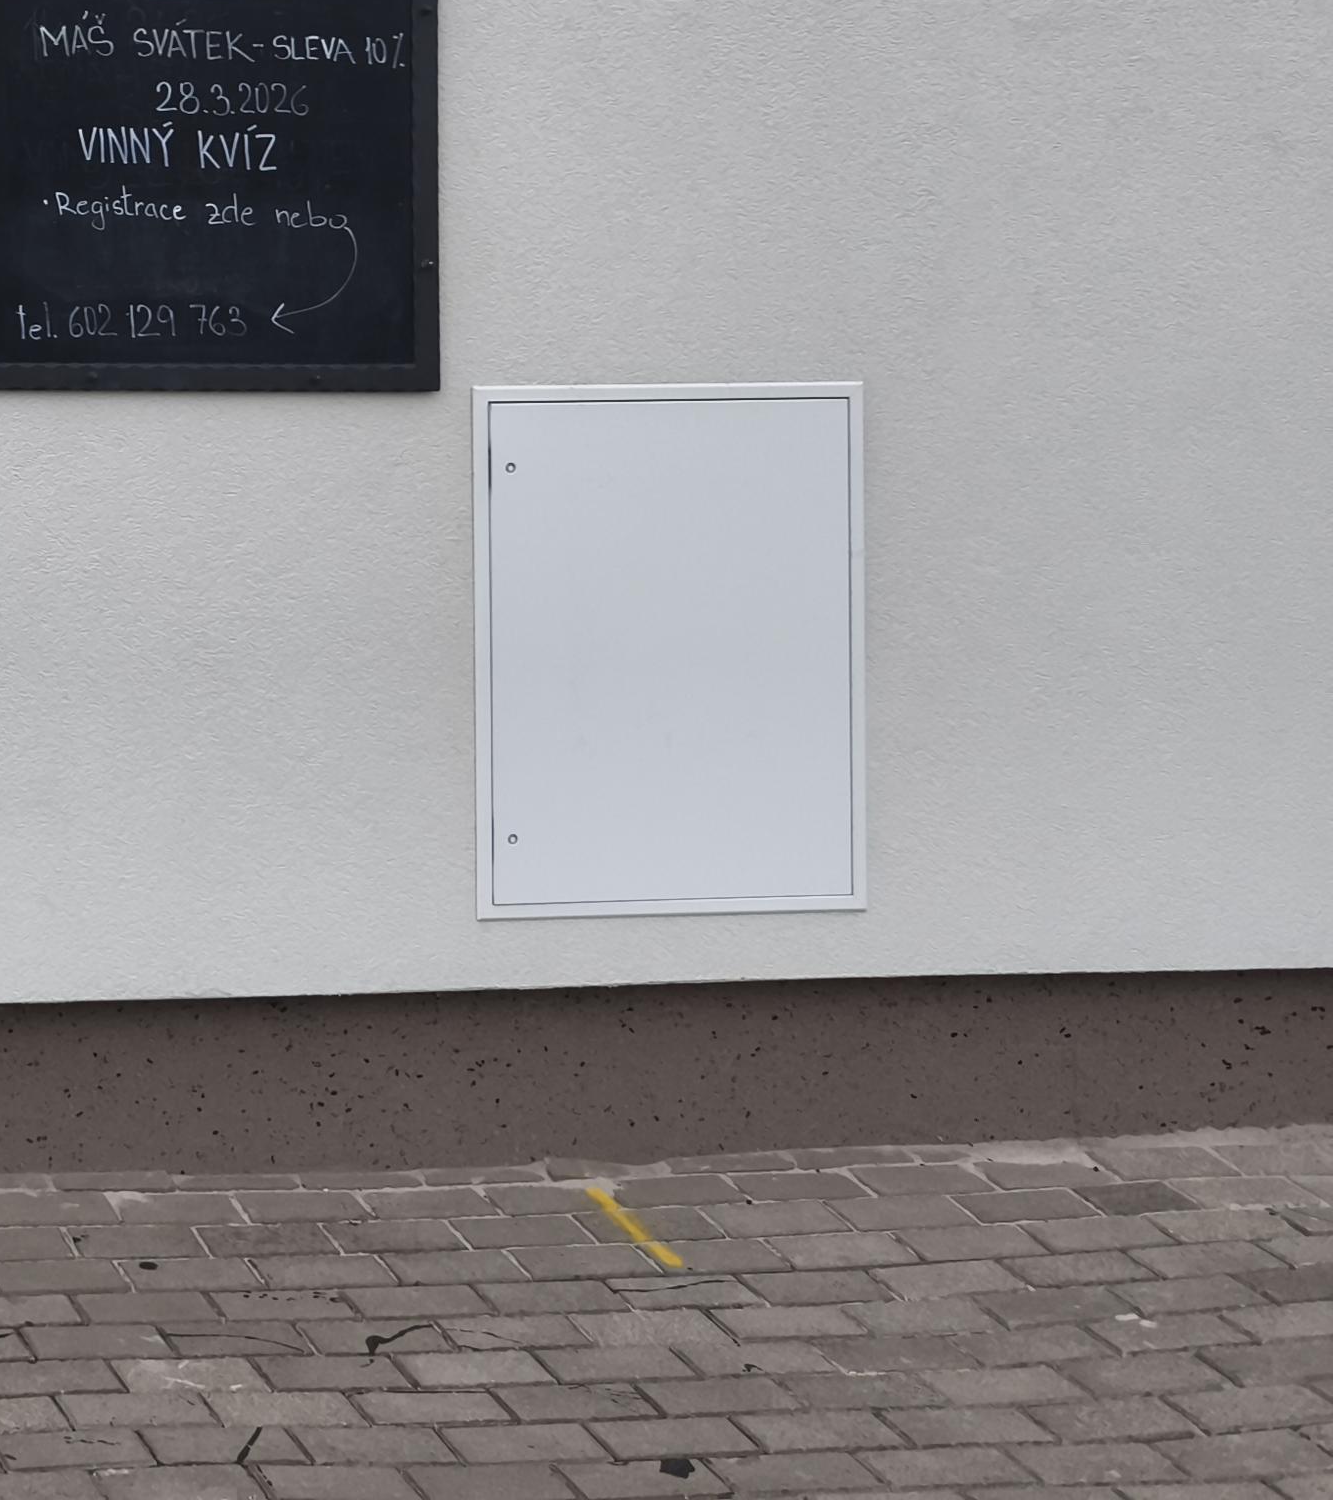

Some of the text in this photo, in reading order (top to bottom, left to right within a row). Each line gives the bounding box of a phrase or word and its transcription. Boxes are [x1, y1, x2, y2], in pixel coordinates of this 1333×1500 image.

[39, 10, 115, 58] MÁŠ
[155, 80, 310, 116] 28.3.2026
[78, 121, 278, 171] VINNÝ KVÍZ
[55, 185, 349, 230] Registrace zde nebo
[16, 301, 248, 340] tel. 602 129 763
